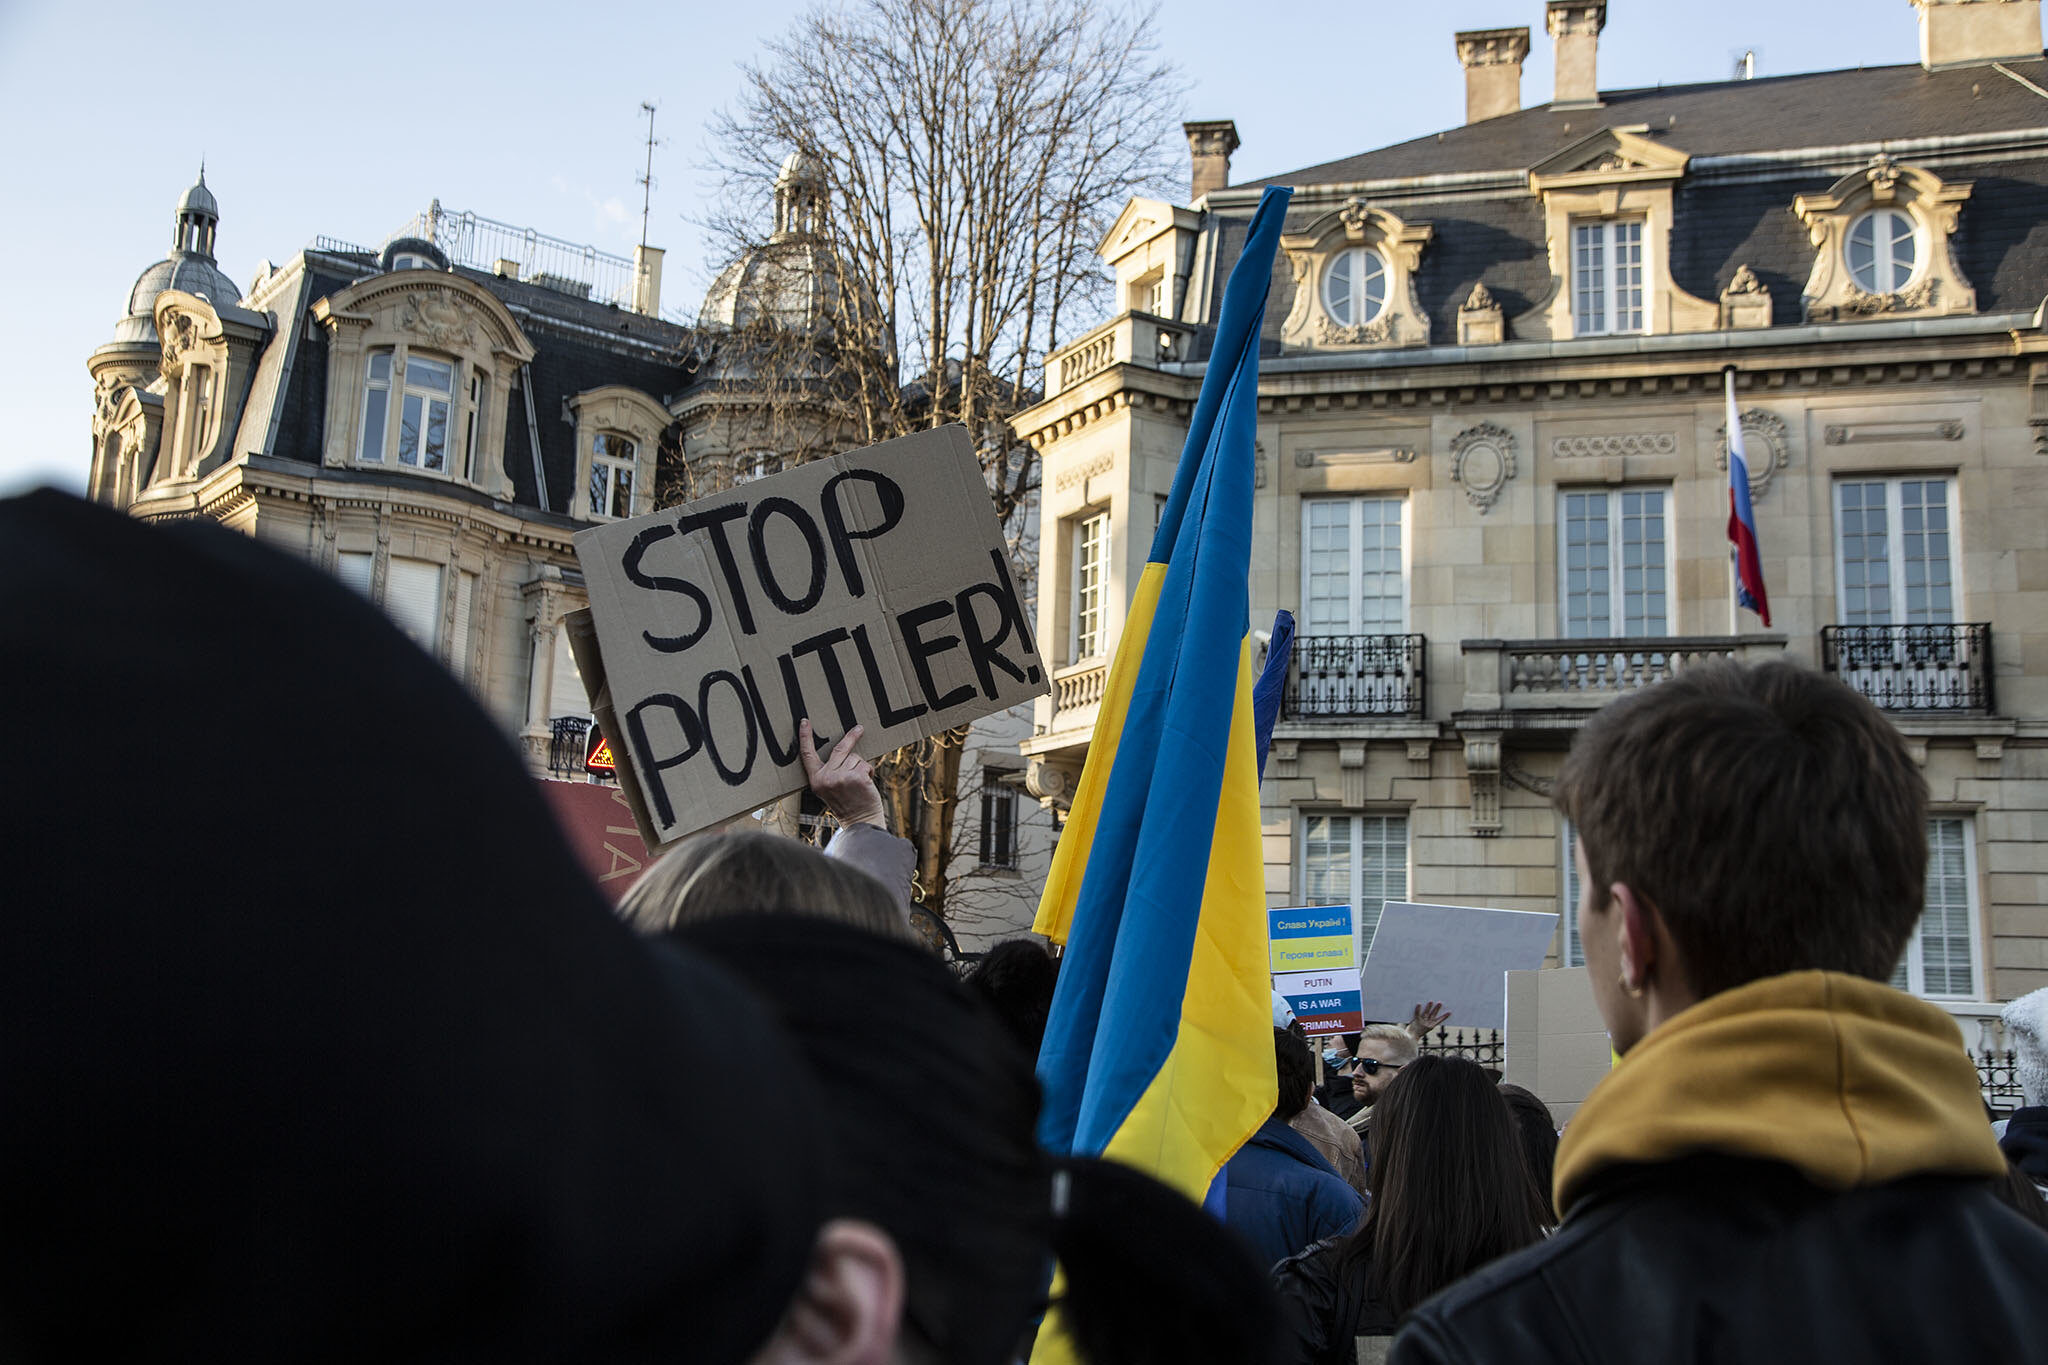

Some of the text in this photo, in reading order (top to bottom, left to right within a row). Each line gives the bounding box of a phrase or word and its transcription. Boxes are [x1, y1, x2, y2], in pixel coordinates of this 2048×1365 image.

[622, 468, 905, 654] STOP
[625, 547, 1041, 830] POUTLER!
[1277, 920, 1307, 930] Слава
[1308, 917, 1341, 929] Україні
[1280, 951, 1314, 961] Героям
[1316, 949, 1344, 958] слава
[1304, 978, 1333, 988] PUTIN
[1299, 998, 1342, 1010] IS A WAR
